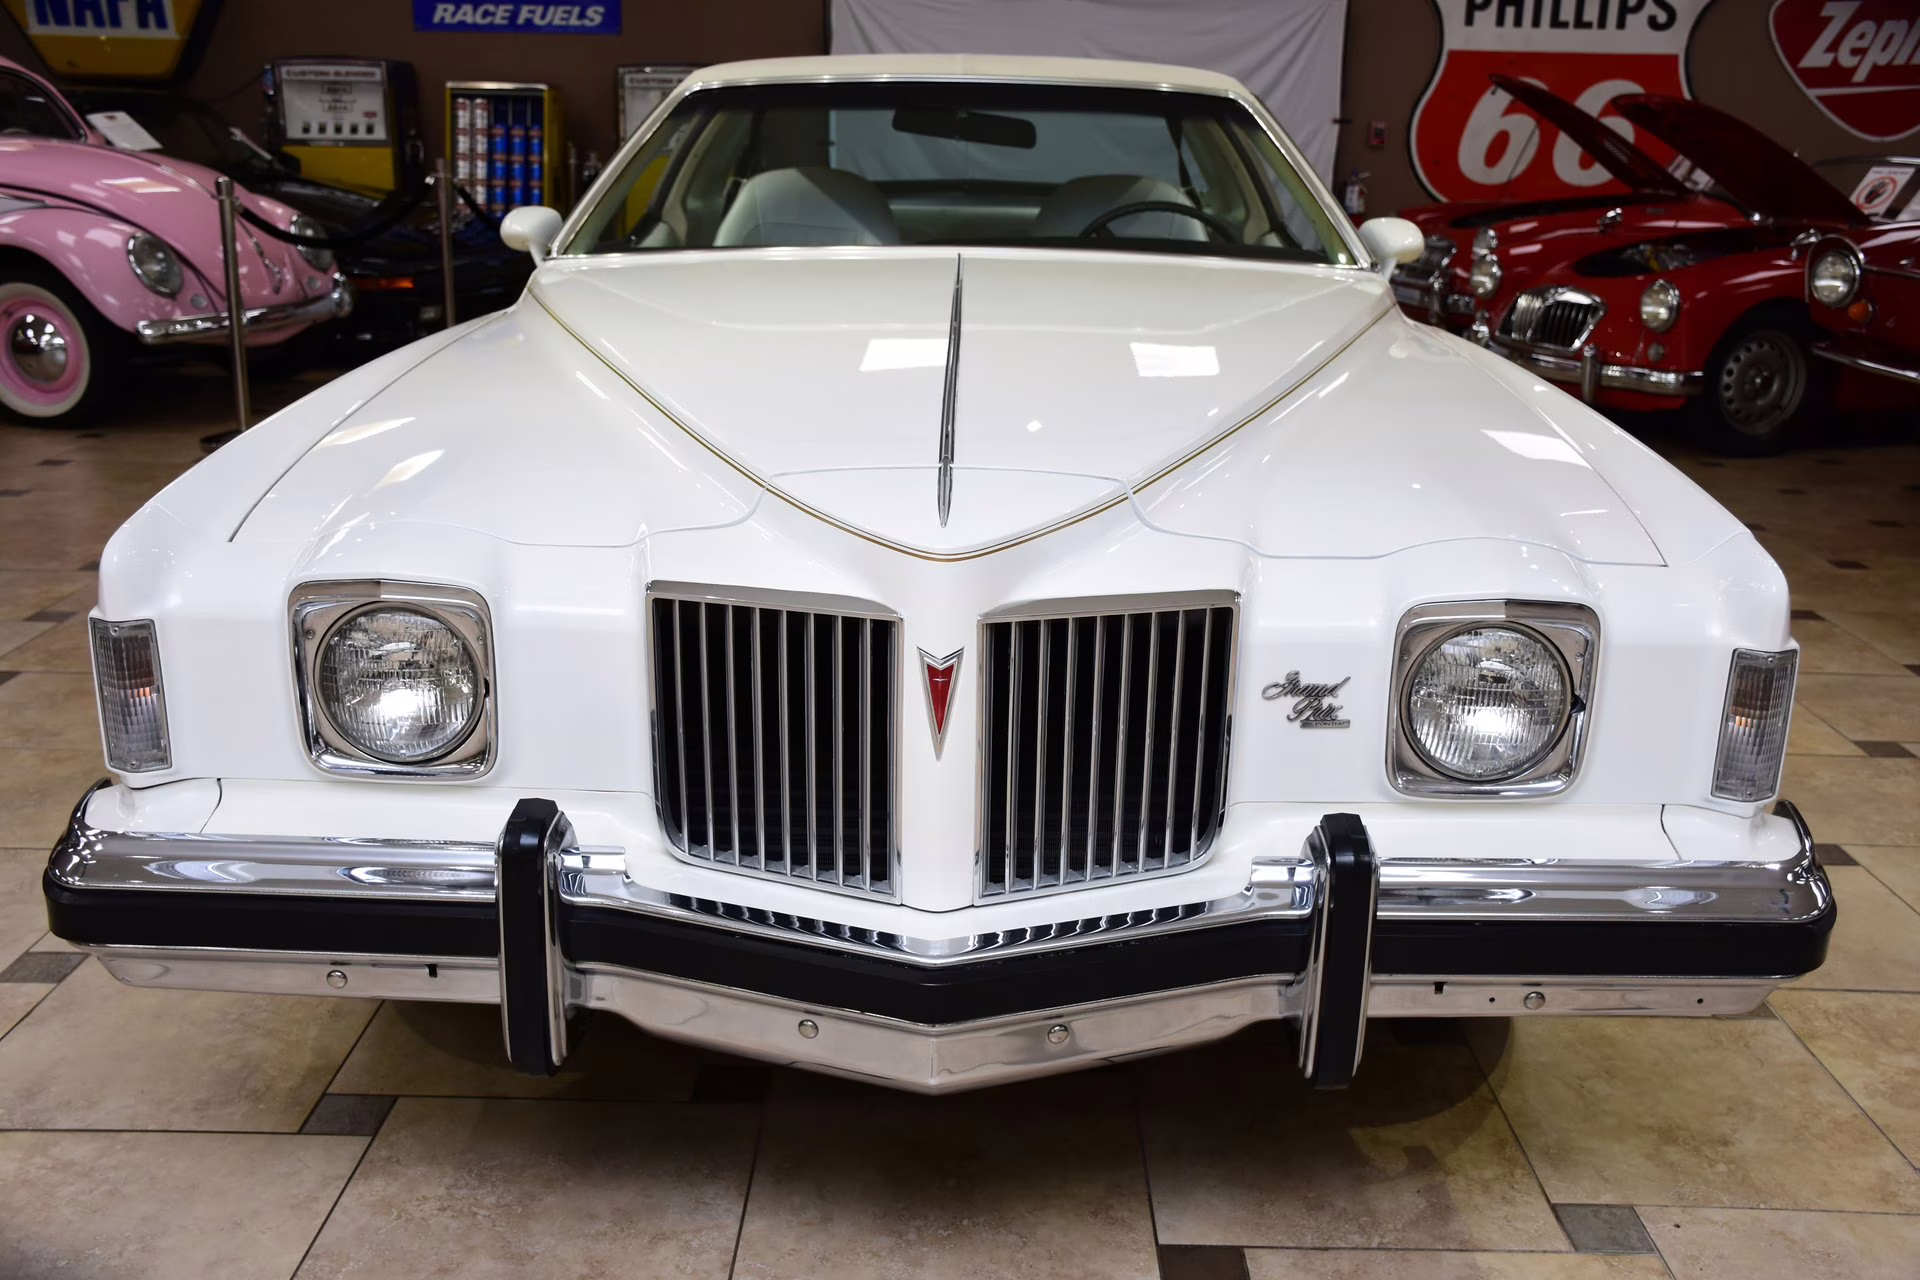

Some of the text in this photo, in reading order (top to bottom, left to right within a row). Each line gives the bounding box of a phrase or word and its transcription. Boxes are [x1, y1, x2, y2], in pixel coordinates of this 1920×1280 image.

[432, 3, 605, 26] RACE FUELS
[1464, 0, 1677, 32] PHILLIPS
[1458, 76, 1647, 187] 66
[1262, 670, 1351, 700] Grand
[1287, 697, 1343, 721] Prix
